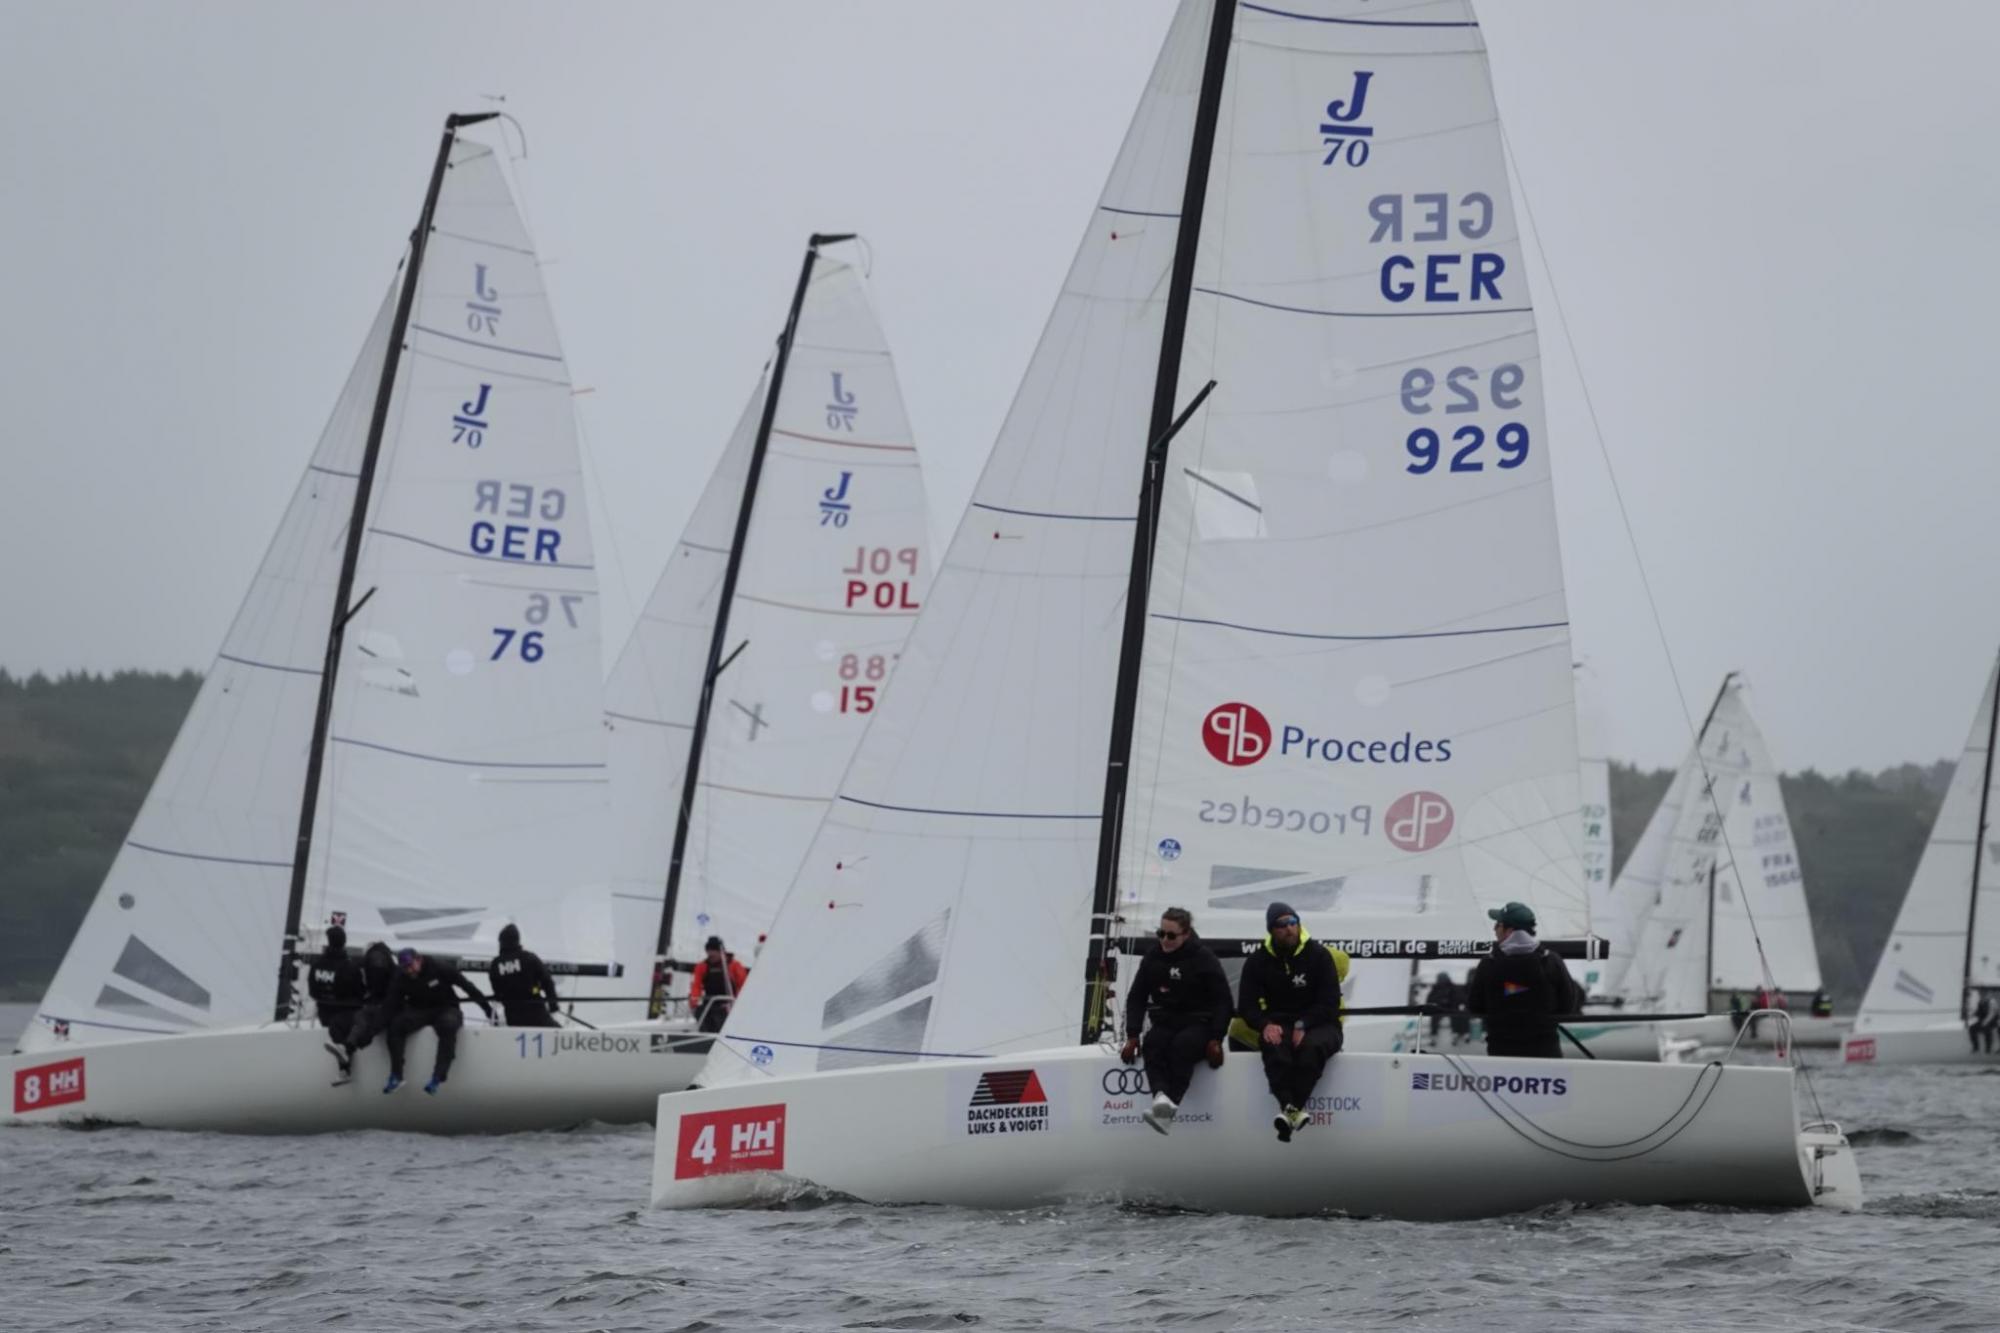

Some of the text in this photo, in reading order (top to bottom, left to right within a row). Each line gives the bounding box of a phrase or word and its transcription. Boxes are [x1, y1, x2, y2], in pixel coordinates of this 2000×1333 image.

[1326, 71, 1374, 122] J
[1322, 138, 1370, 167] 70
[1380, 253, 1505, 302] GER
[452, 424, 483, 449] 70
[1406, 422, 1530, 475] 929
[819, 509, 848, 529] 70
[470, 520, 562, 563] GER
[846, 579, 920, 609] POL
[489, 626, 545, 664] 76
[840, 685, 876, 713] 15
[1280, 724, 1453, 764] Procedes
[515, 1030, 641, 1059] 11 jukebox
[23, 1074, 41, 1104] 8
[1430, 1072, 1568, 1097] EUROPORTS
[967, 1104, 1049, 1122] DACHDECKEREI
[1102, 1112, 1147, 1126] Zentru
[1103, 1099, 1134, 1111] Audi
[1308, 1111, 1334, 1126] ORT
[967, 1121, 996, 1135] LUKS
[998, 1121, 1008, 1134] &
[1008, 1119, 1043, 1133] VOIGT
[690, 1120, 777, 1165] 4 HH
